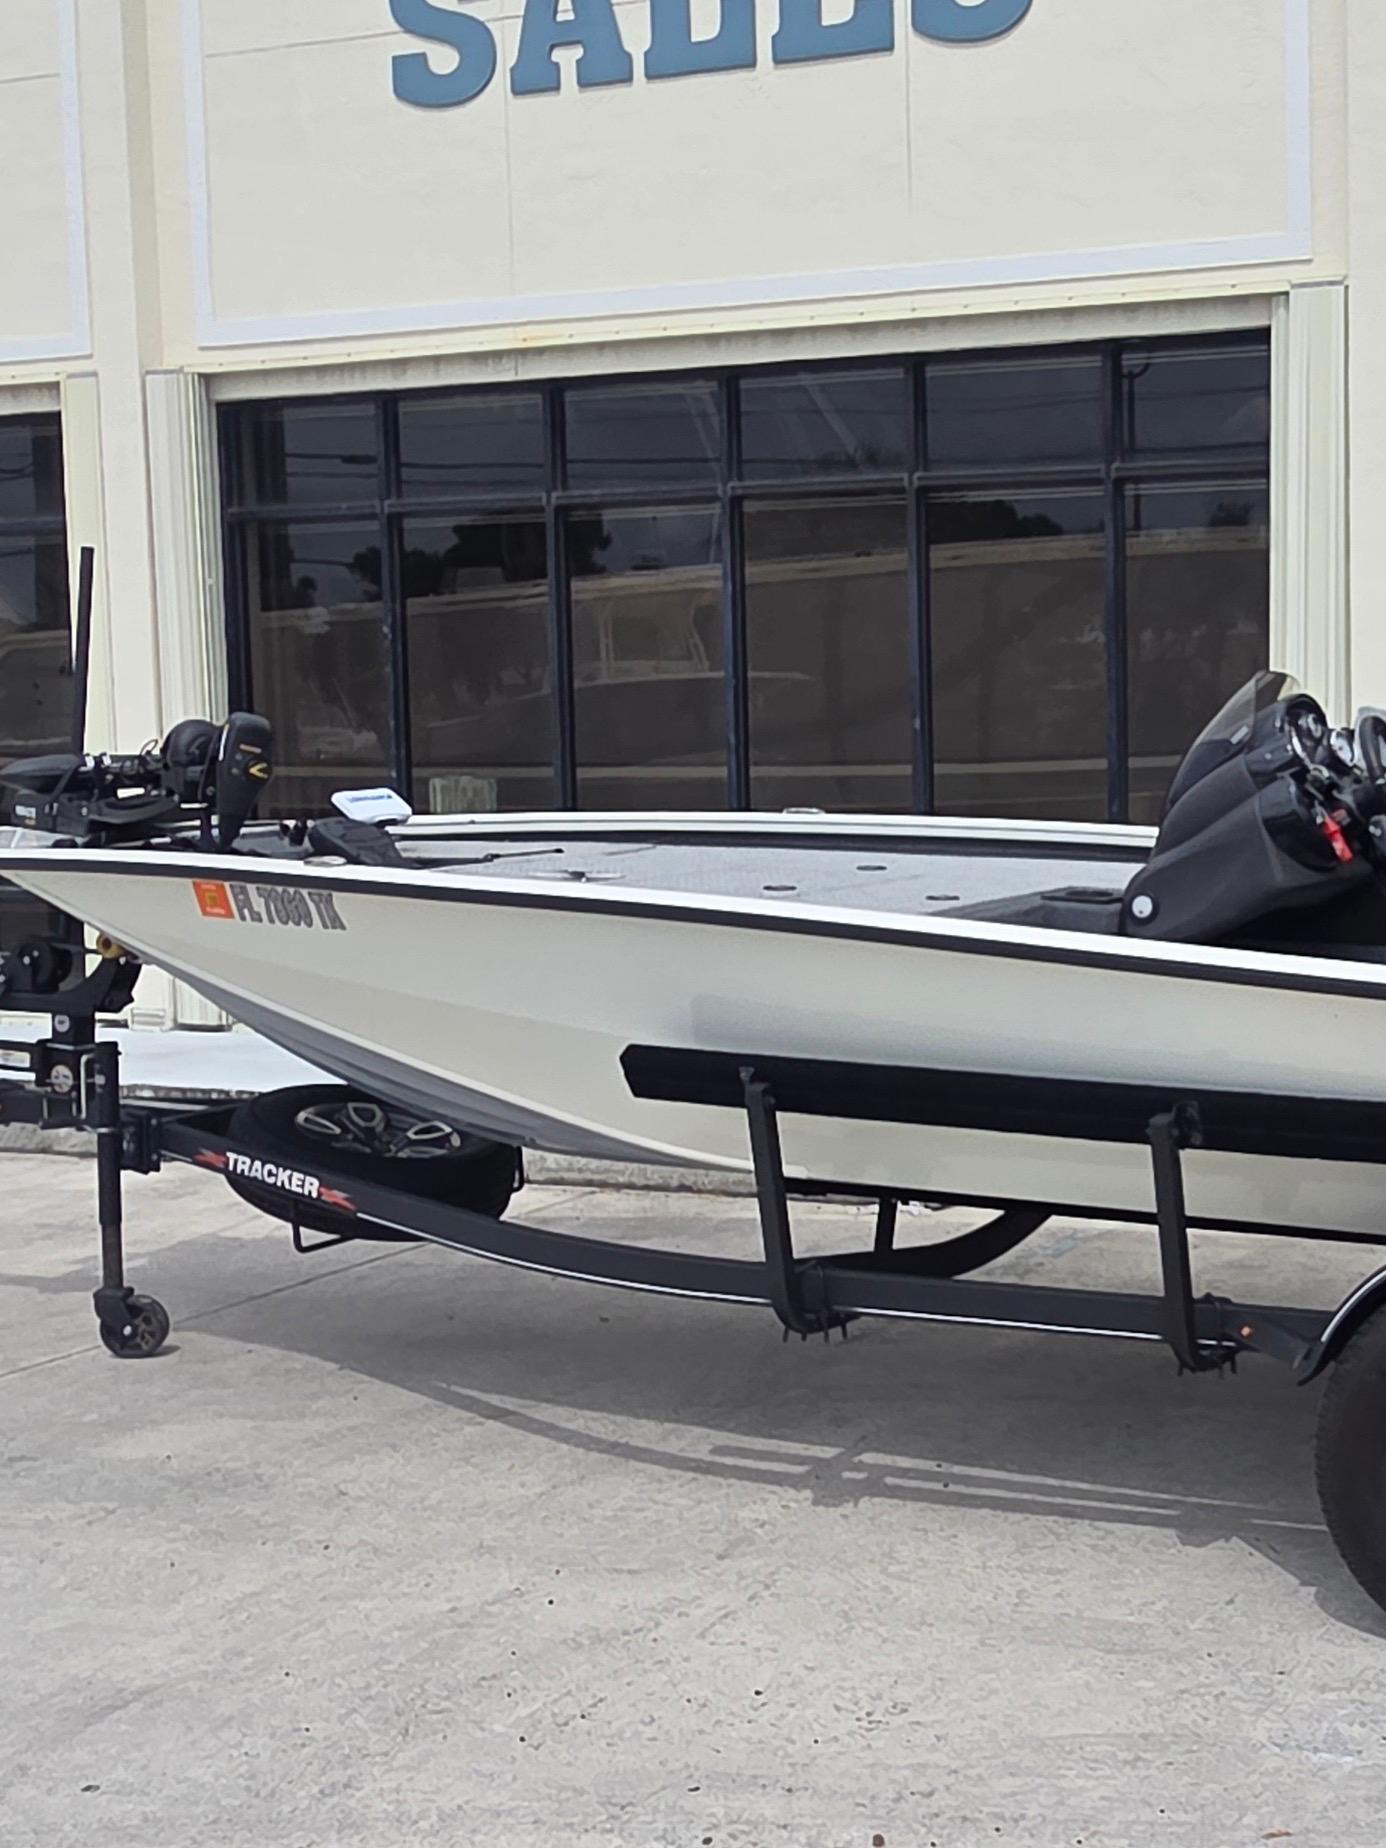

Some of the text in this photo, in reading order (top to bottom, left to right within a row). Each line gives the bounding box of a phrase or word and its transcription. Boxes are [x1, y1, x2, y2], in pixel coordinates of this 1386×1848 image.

[391, 0, 1034, 107] SAL
[229, 883, 263, 923] FL
[226, 1151, 320, 1199] TRACKER
